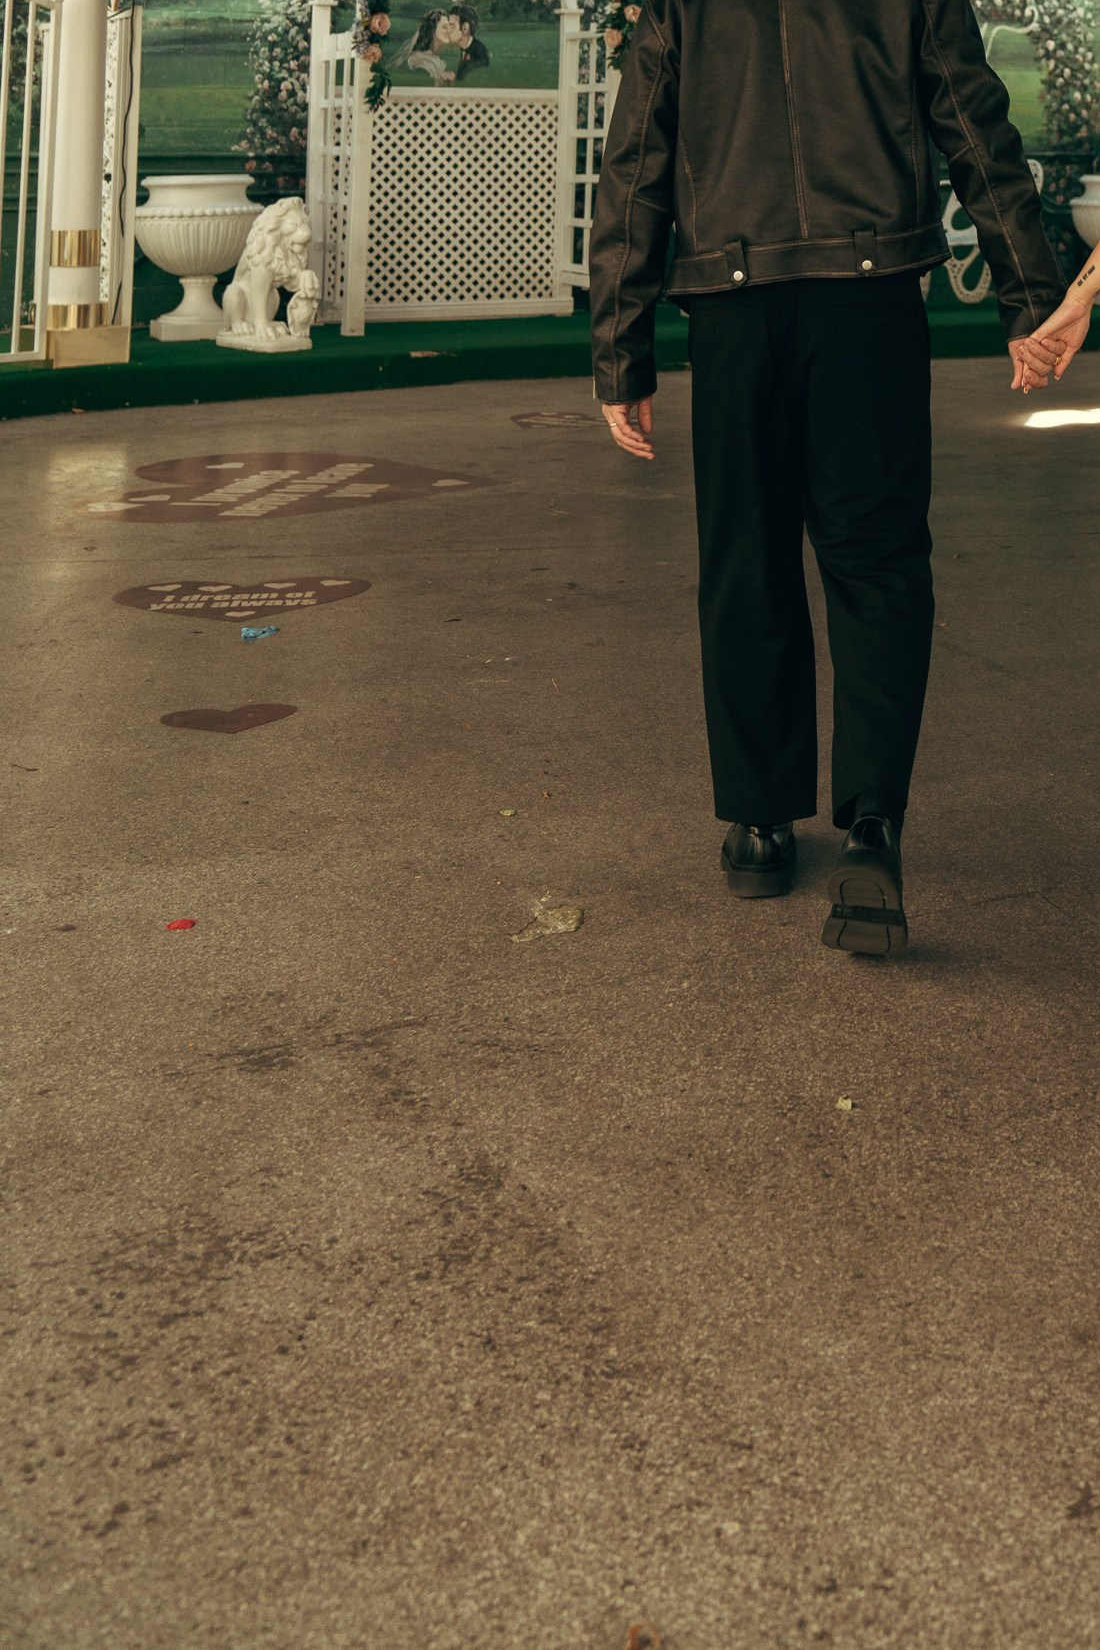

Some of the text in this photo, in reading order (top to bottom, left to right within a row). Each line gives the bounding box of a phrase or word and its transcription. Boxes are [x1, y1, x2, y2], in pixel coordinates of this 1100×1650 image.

[163, 590, 317, 603] I dream of
[149, 598, 318, 611] you always
